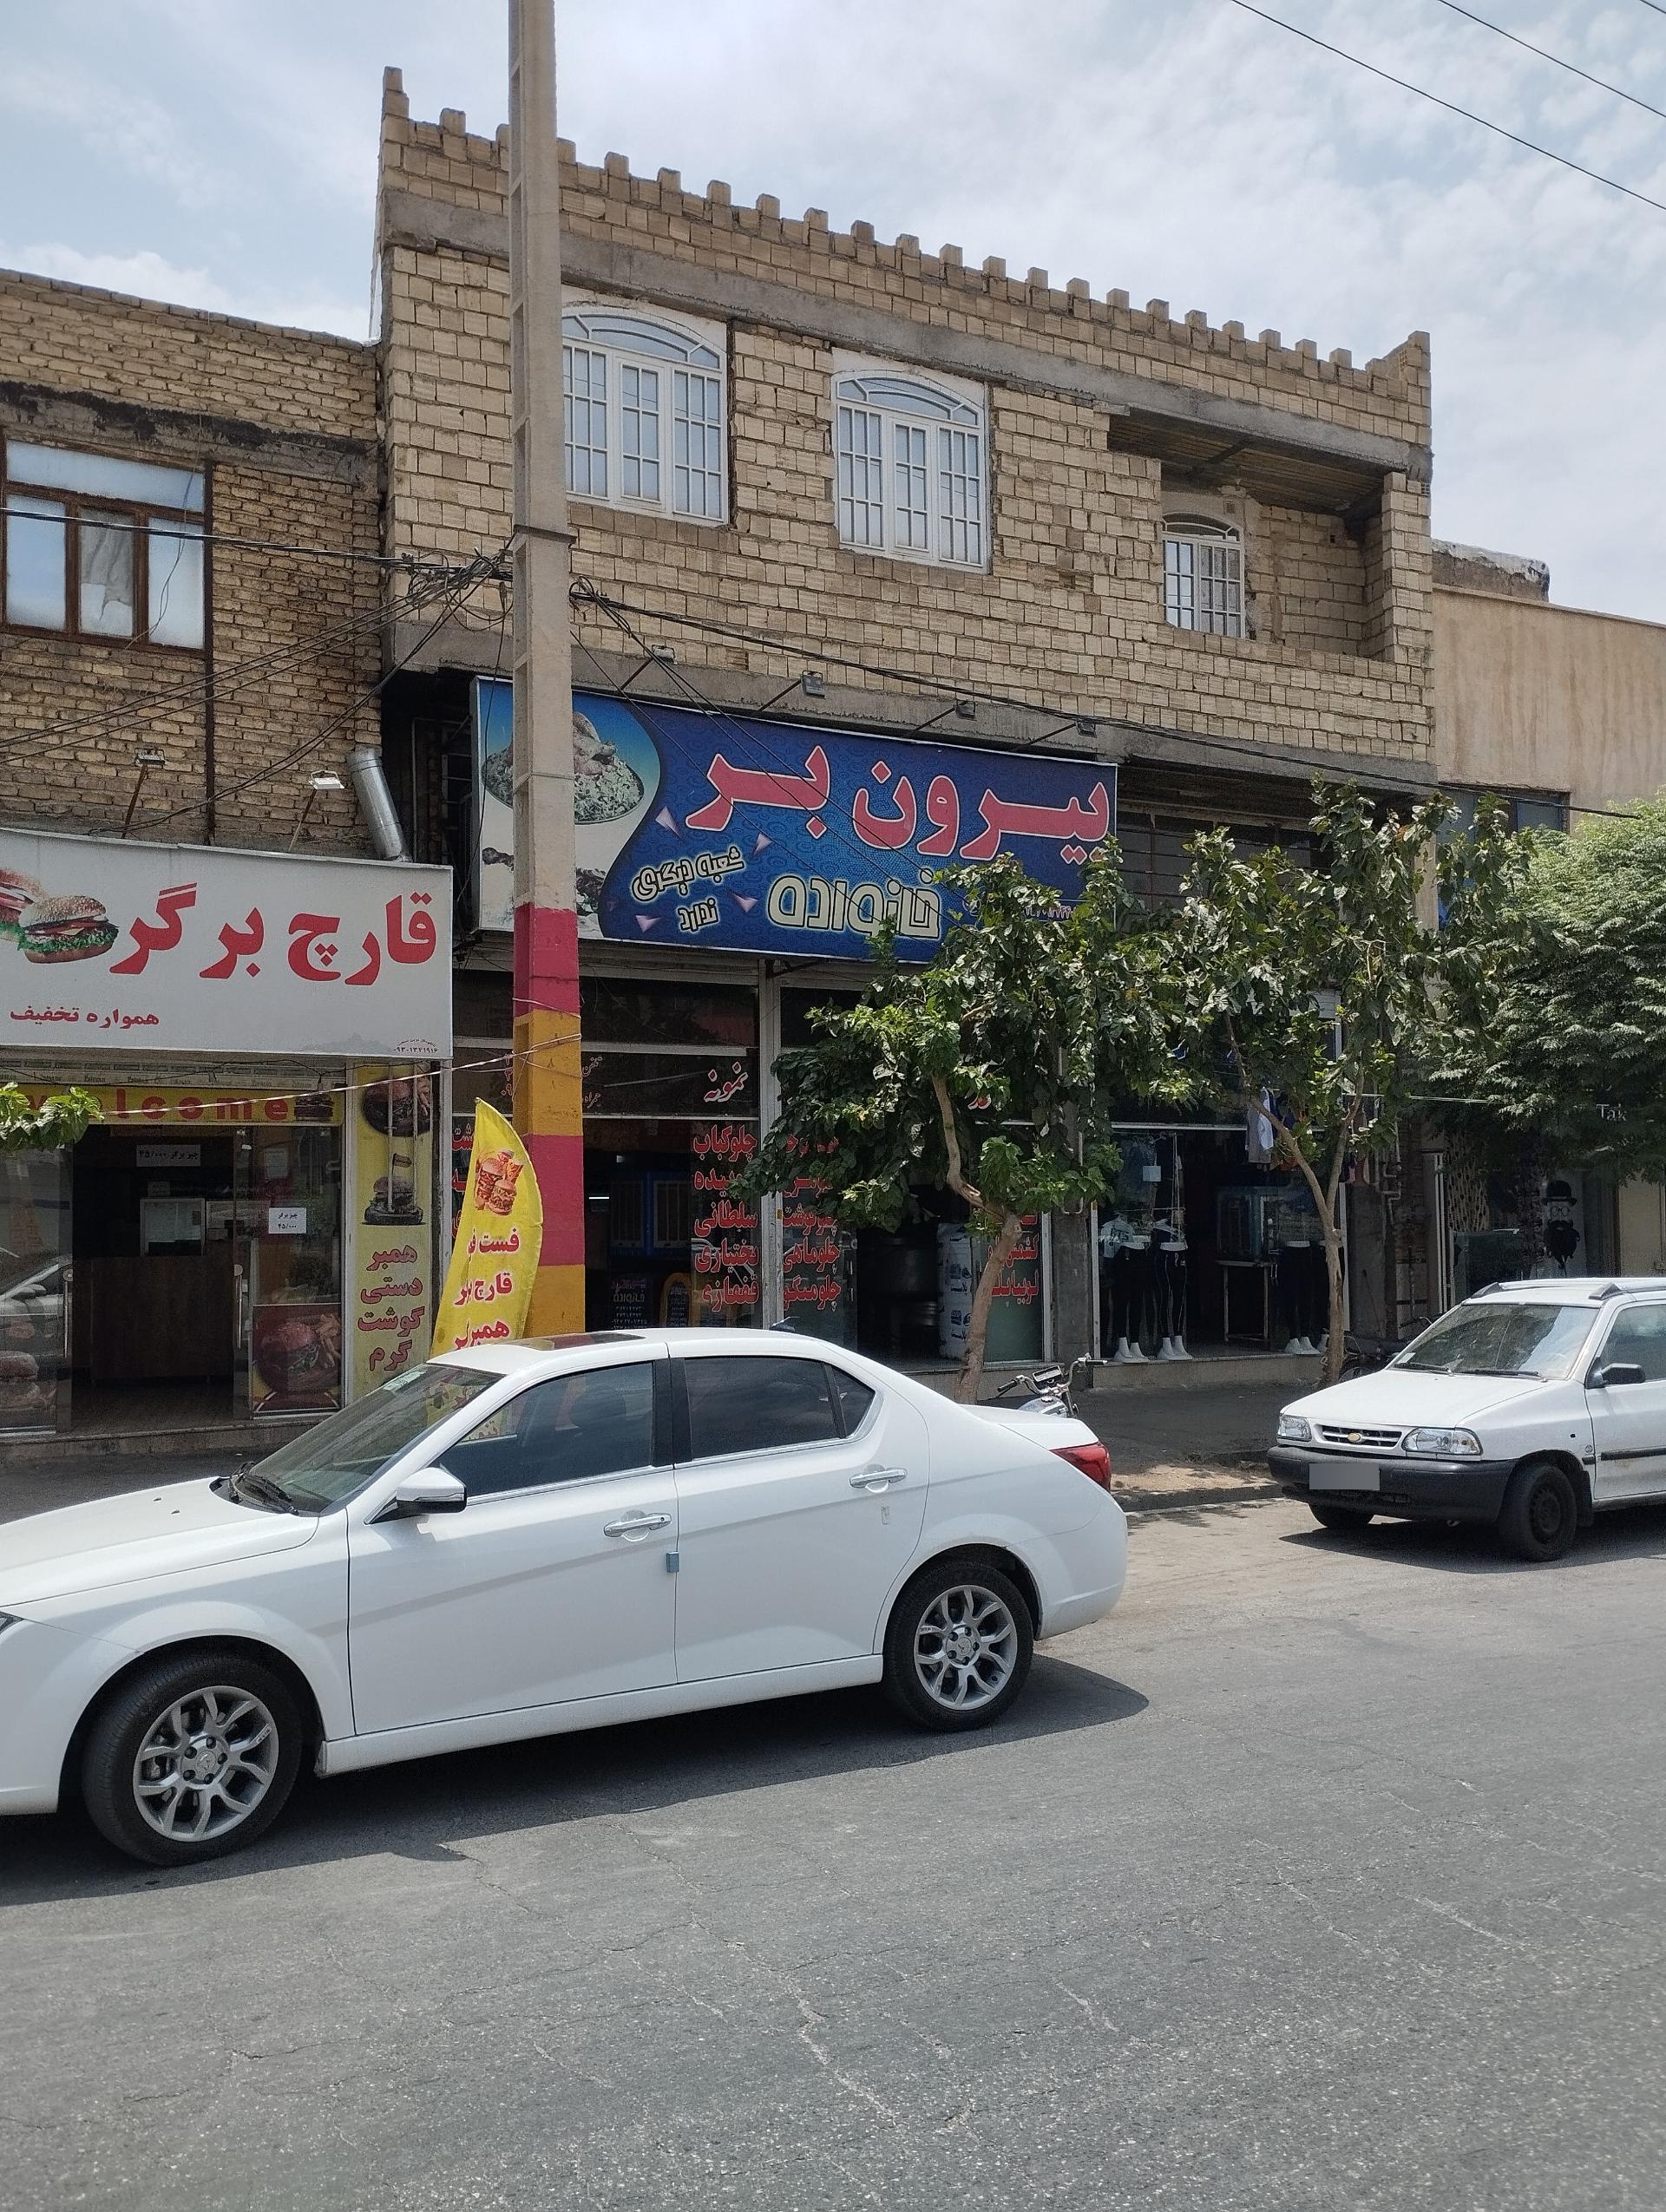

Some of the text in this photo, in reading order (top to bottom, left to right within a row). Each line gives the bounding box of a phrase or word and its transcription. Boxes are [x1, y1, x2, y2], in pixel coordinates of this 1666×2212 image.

[685, 745, 1110, 866] بیرون بر
[632, 845, 745, 902] شعبه دیگری
[678, 897, 719, 933] ندارد
[768, 867, 941, 939] خانواده
[287, 891, 437, 986] قارچ
[10, 1005, 160, 1029] همواره تخفیف
[704, 1061, 749, 1103] نمونه
[23, 1089, 289, 1121] lcome
[693, 1124, 758, 1162] چلوکباب
[694, 1200, 758, 1238] سلطانی
[479, 1227, 520, 1253] فست
[366, 1245, 418, 1272] همبر
[361, 1277, 423, 1304] دستی
[474, 1273, 513, 1301] قارچ
[357, 1306, 425, 1337] گوشت
[370, 1339, 412, 1371] گرم
